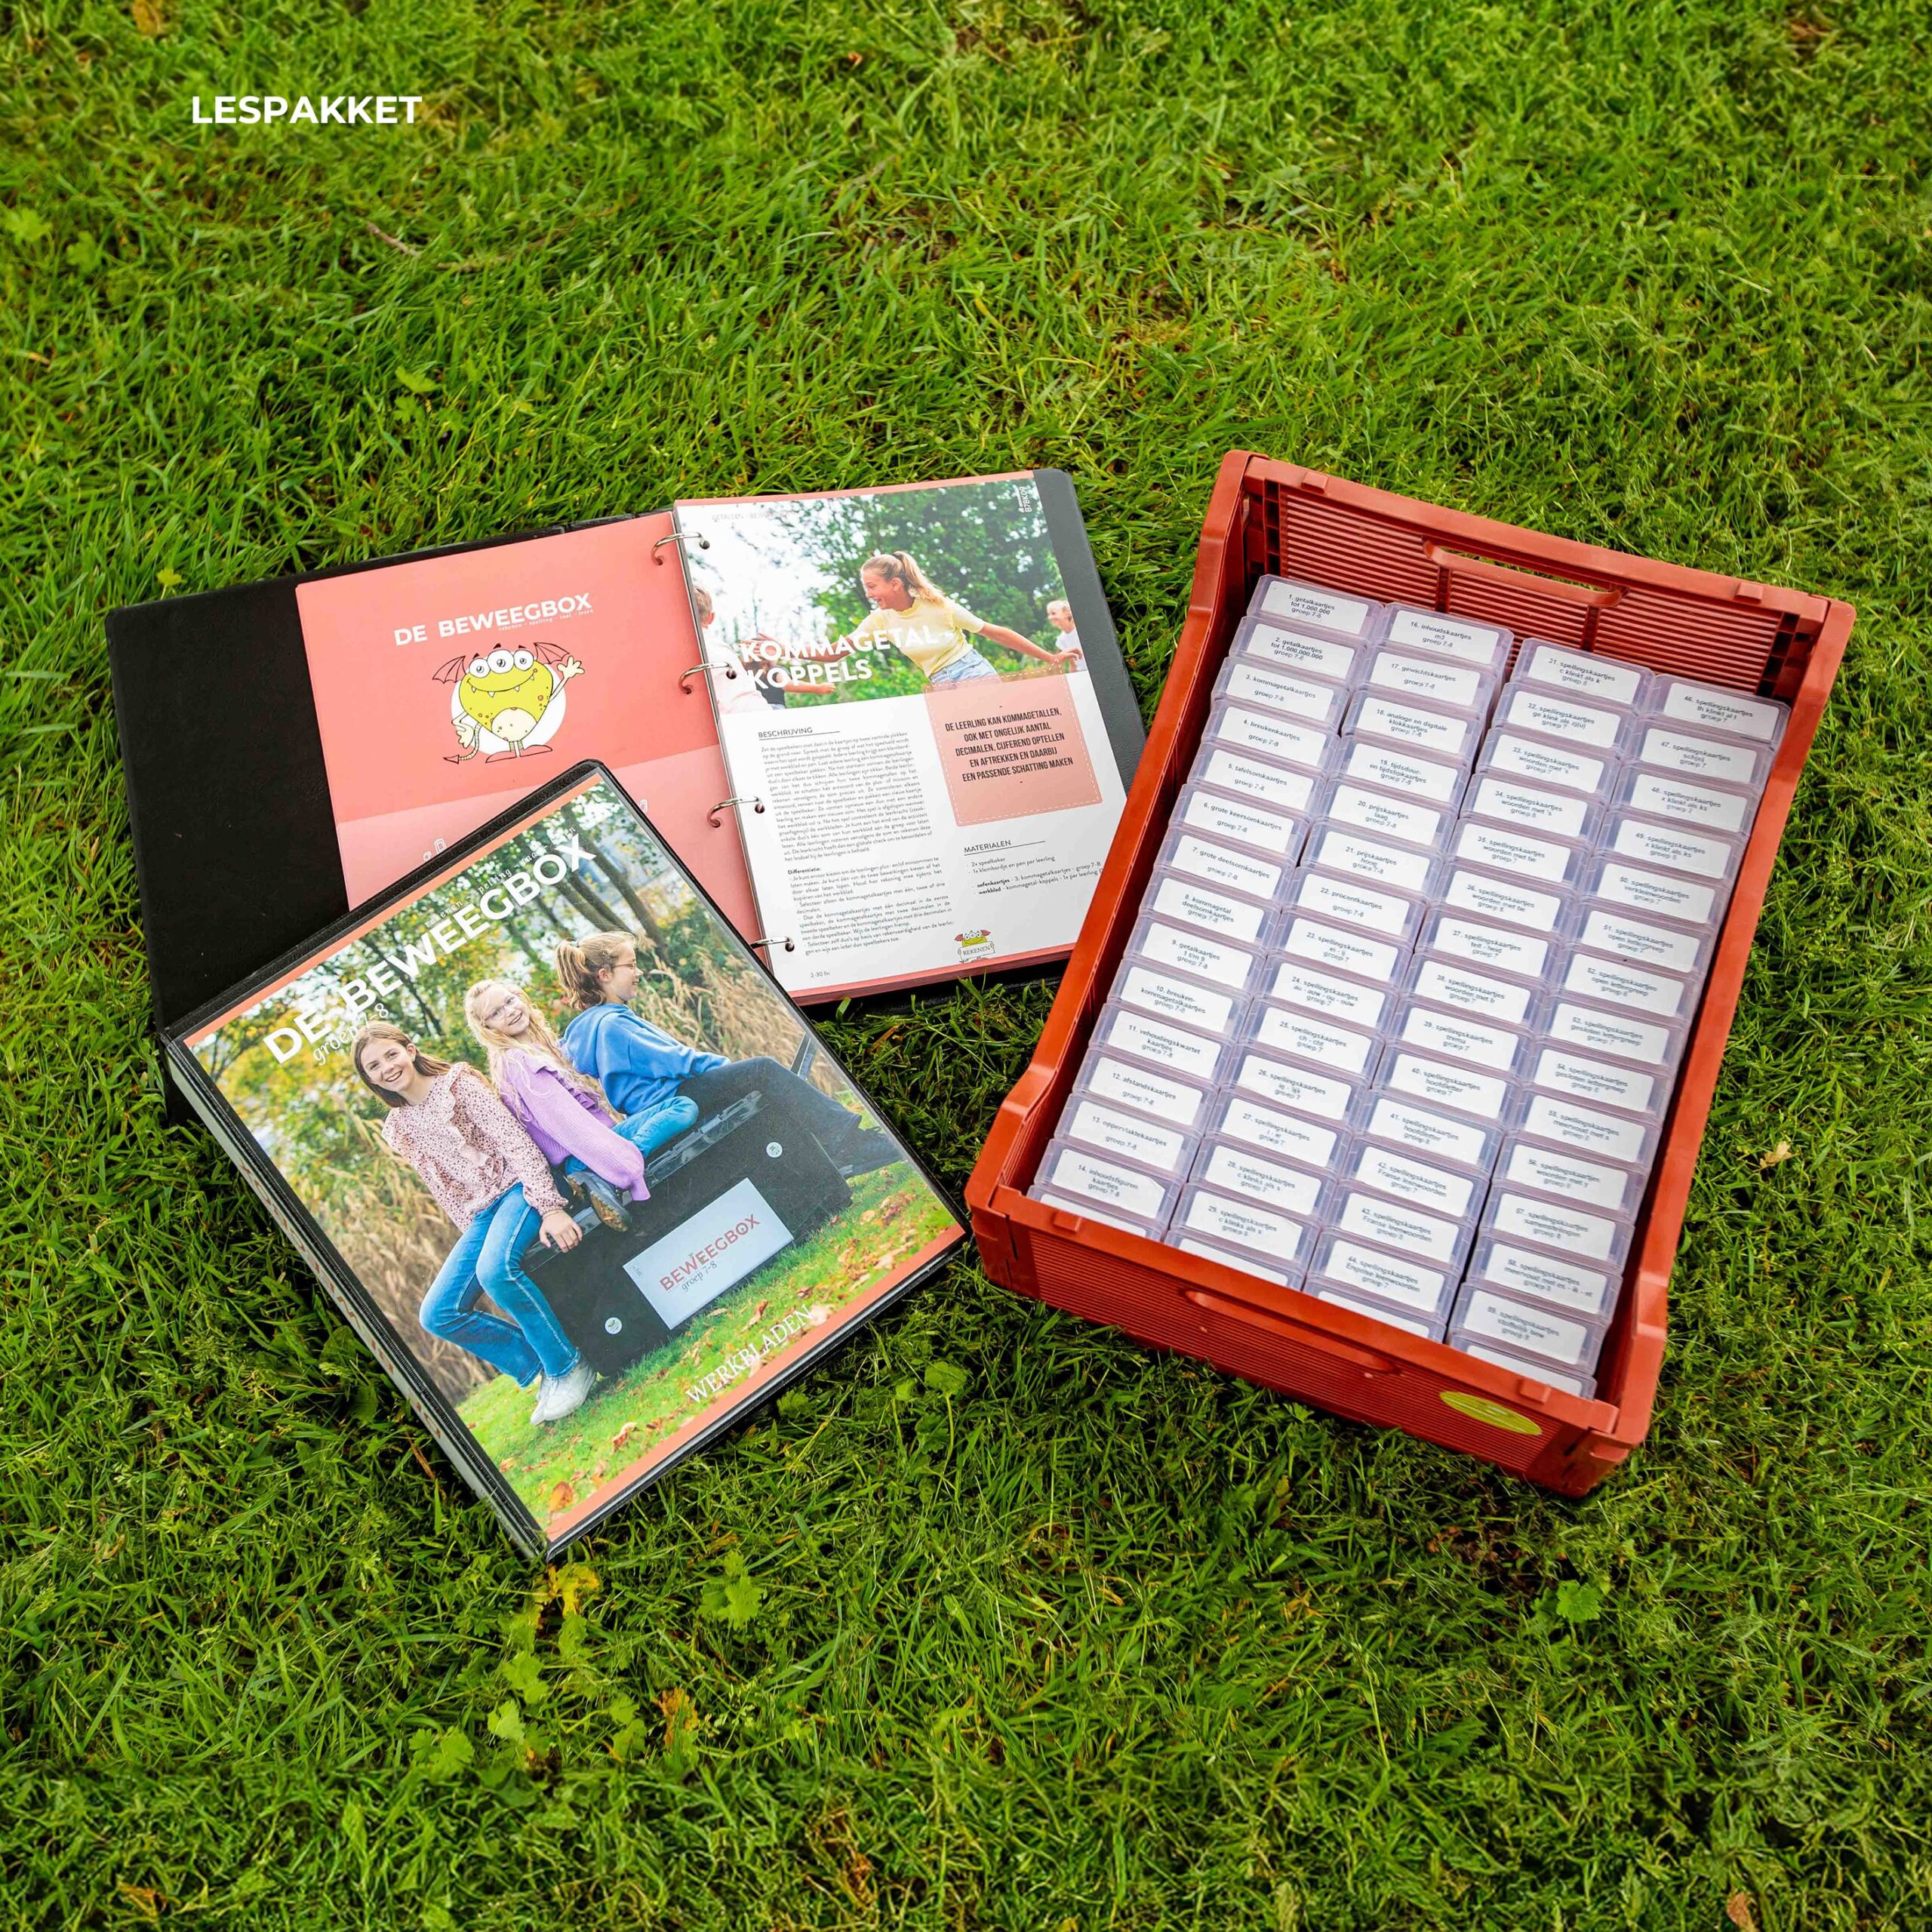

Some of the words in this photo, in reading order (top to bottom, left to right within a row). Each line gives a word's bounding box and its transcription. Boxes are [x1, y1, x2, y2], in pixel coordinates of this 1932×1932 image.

[1294, 596, 1334, 611] getalkaartjes
[394, 625, 428, 646] DE
[438, 592, 592, 638] BEWEEGBOX
[1291, 608, 1310, 616] groep
[1420, 624, 1471, 639] inhoudskaartjes
[740, 625, 938, 663] KOMMAGETAL
[1281, 639, 1321, 654] getalkaartjes
[1422, 637, 1441, 645] groep
[1274, 649, 1293, 658] groep
[747, 659, 872, 691] KOPPELS
[1401, 666, 1456, 681] gewichtskaartjes
[1561, 675, 1582, 685] groep
[1253, 676, 1315, 698] kommagetalkaartjes
[1254, 690, 1273, 699] groep
[944, 722, 955, 731] DE
[955, 718, 986, 730] LEERLING
[986, 716, 1001, 725] KAN
[1001, 707, 1061, 723] KOMMAGETALLEN,
[1386, 712, 1412, 722] analoge
[1423, 721, 1447, 731] digitale
[1389, 718, 1428, 733] klokkaartjes
[1541, 720, 1561, 728] groep
[758, 727, 813, 738] BESCHRIJVING
[963, 732, 978, 742] OOK
[978, 730, 992, 740] MET
[993, 725, 1025, 737] ONGELIJK
[1026, 721, 1051, 733] AANTAL
[1390, 726, 1410, 734] groep
[955, 743, 995, 756] DECIMALEN,
[995, 737, 1031, 750] CIJFEREND
[1031, 732, 1065, 745] OPTELLEN
[969, 758, 979, 767] EN
[980, 752, 1019, 766] AFTREKKEN
[1019, 751, 1029, 760] EN
[1029, 746, 1057, 758] DAARBIJ
[961, 772, 976, 782] EEN
[976, 766, 1011, 780] PASSENDE
[1011, 761, 1048, 774] SCHATTING
[1048, 756, 1073, 768] MAKEN
[1235, 765, 1287, 785] tafelsomkaartjes
[1234, 779, 1253, 788] groep
[1211, 805, 1228, 814] grote
[1229, 810, 1281, 830] keersomkaartjes
[1367, 804, 1408, 819] prijskaartjes
[1374, 811, 1388, 821] laag
[1217, 820, 1236, 829] groep
[1365, 817, 1385, 825] groep
[964, 839, 1011, 853] MATERIALEN
[978, 857, 1005, 866] speelbeker
[978, 864, 1008, 872] klembordje
[1199, 851, 1217, 860] grote
[1217, 857, 1269, 878] deelsomkaartjes
[977, 878, 1010, 888] oefenkaartjes
[1020, 868, 1071, 879] kommagetalkaartjes
[1207, 866, 1226, 876] groep
[473, 866, 512, 900] spelling
[978, 886, 1001, 894] werkblad
[263, 1008, 331, 1064] DE
[337, 833, 596, 1016] BEWEEGBOX
[962, 945, 990, 956] REKENEN
[312, 1023, 359, 1066] groep
[1141, 1044, 1161, 1054] groep
[1442, 1041, 1463, 1050] groep
[659, 1214, 761, 1291] BEWEEGBOX
[681, 1270, 704, 1293] groep
[702, 1260, 718, 1278] 7-8
[685, 1304, 814, 1404] WERKBLADEN
